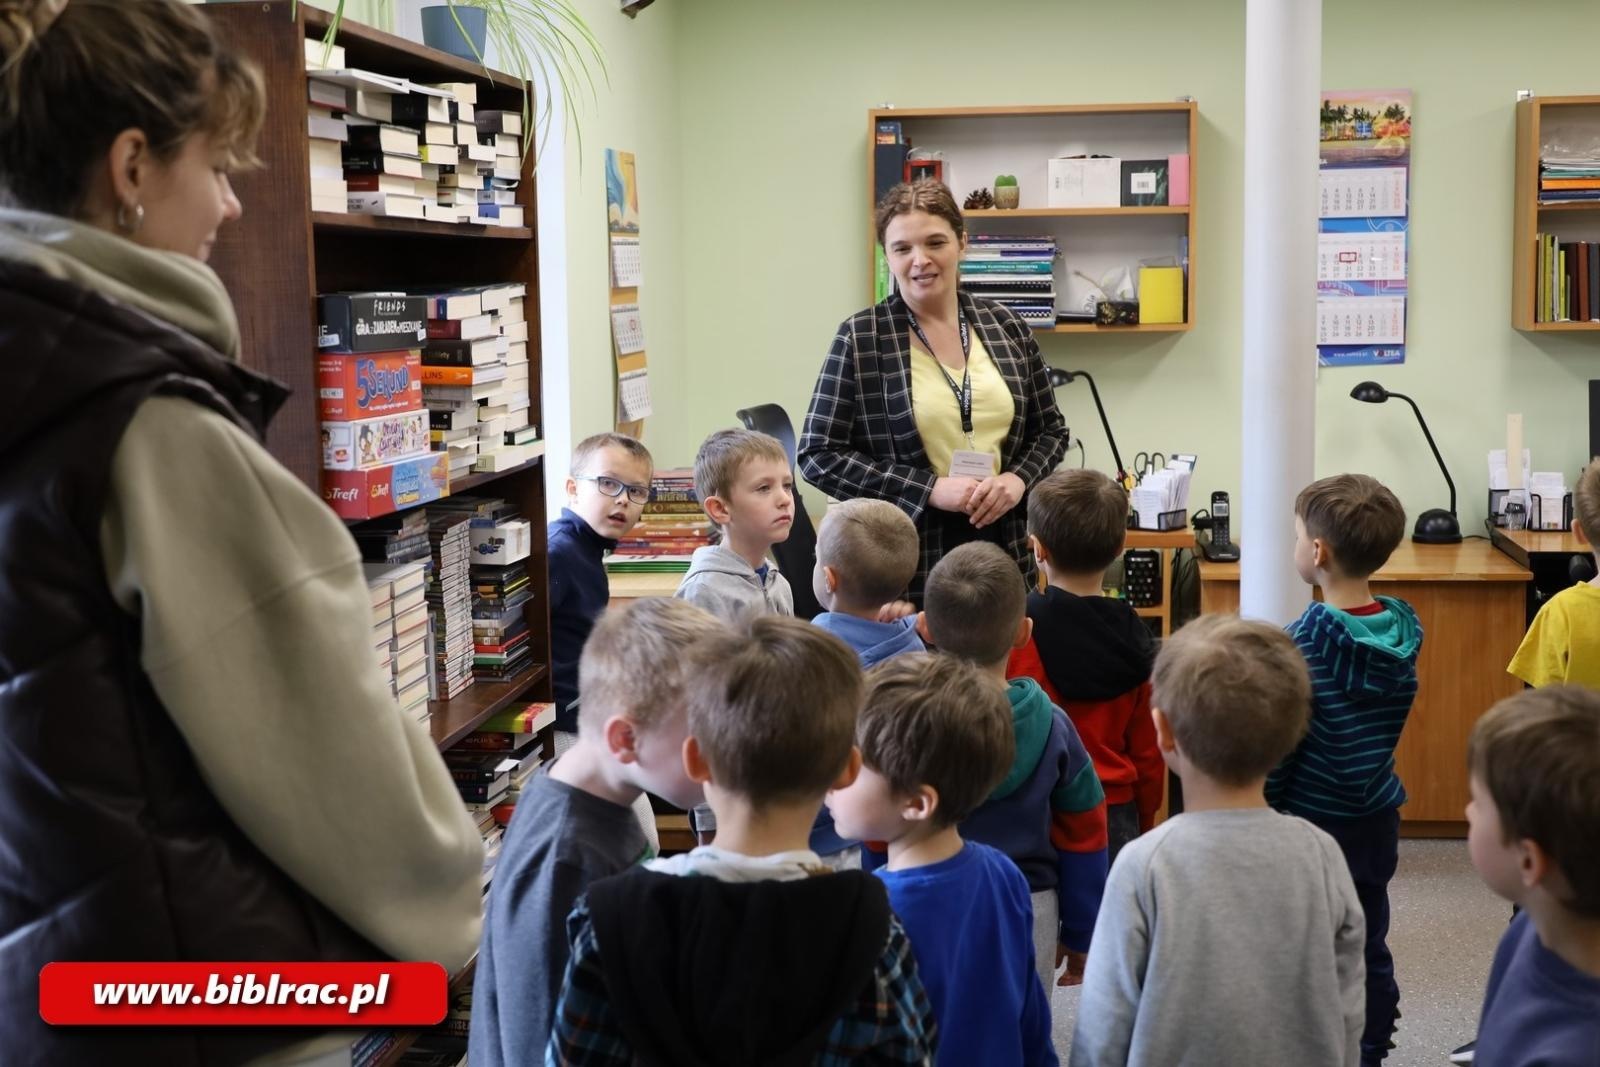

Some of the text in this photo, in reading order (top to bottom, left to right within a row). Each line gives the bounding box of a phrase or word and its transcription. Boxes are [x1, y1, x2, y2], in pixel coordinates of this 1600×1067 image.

[374, 299, 406, 316] FRIENDS
[356, 358, 409, 408] 5 SEKUND
[332, 487, 359, 502] Trefl
